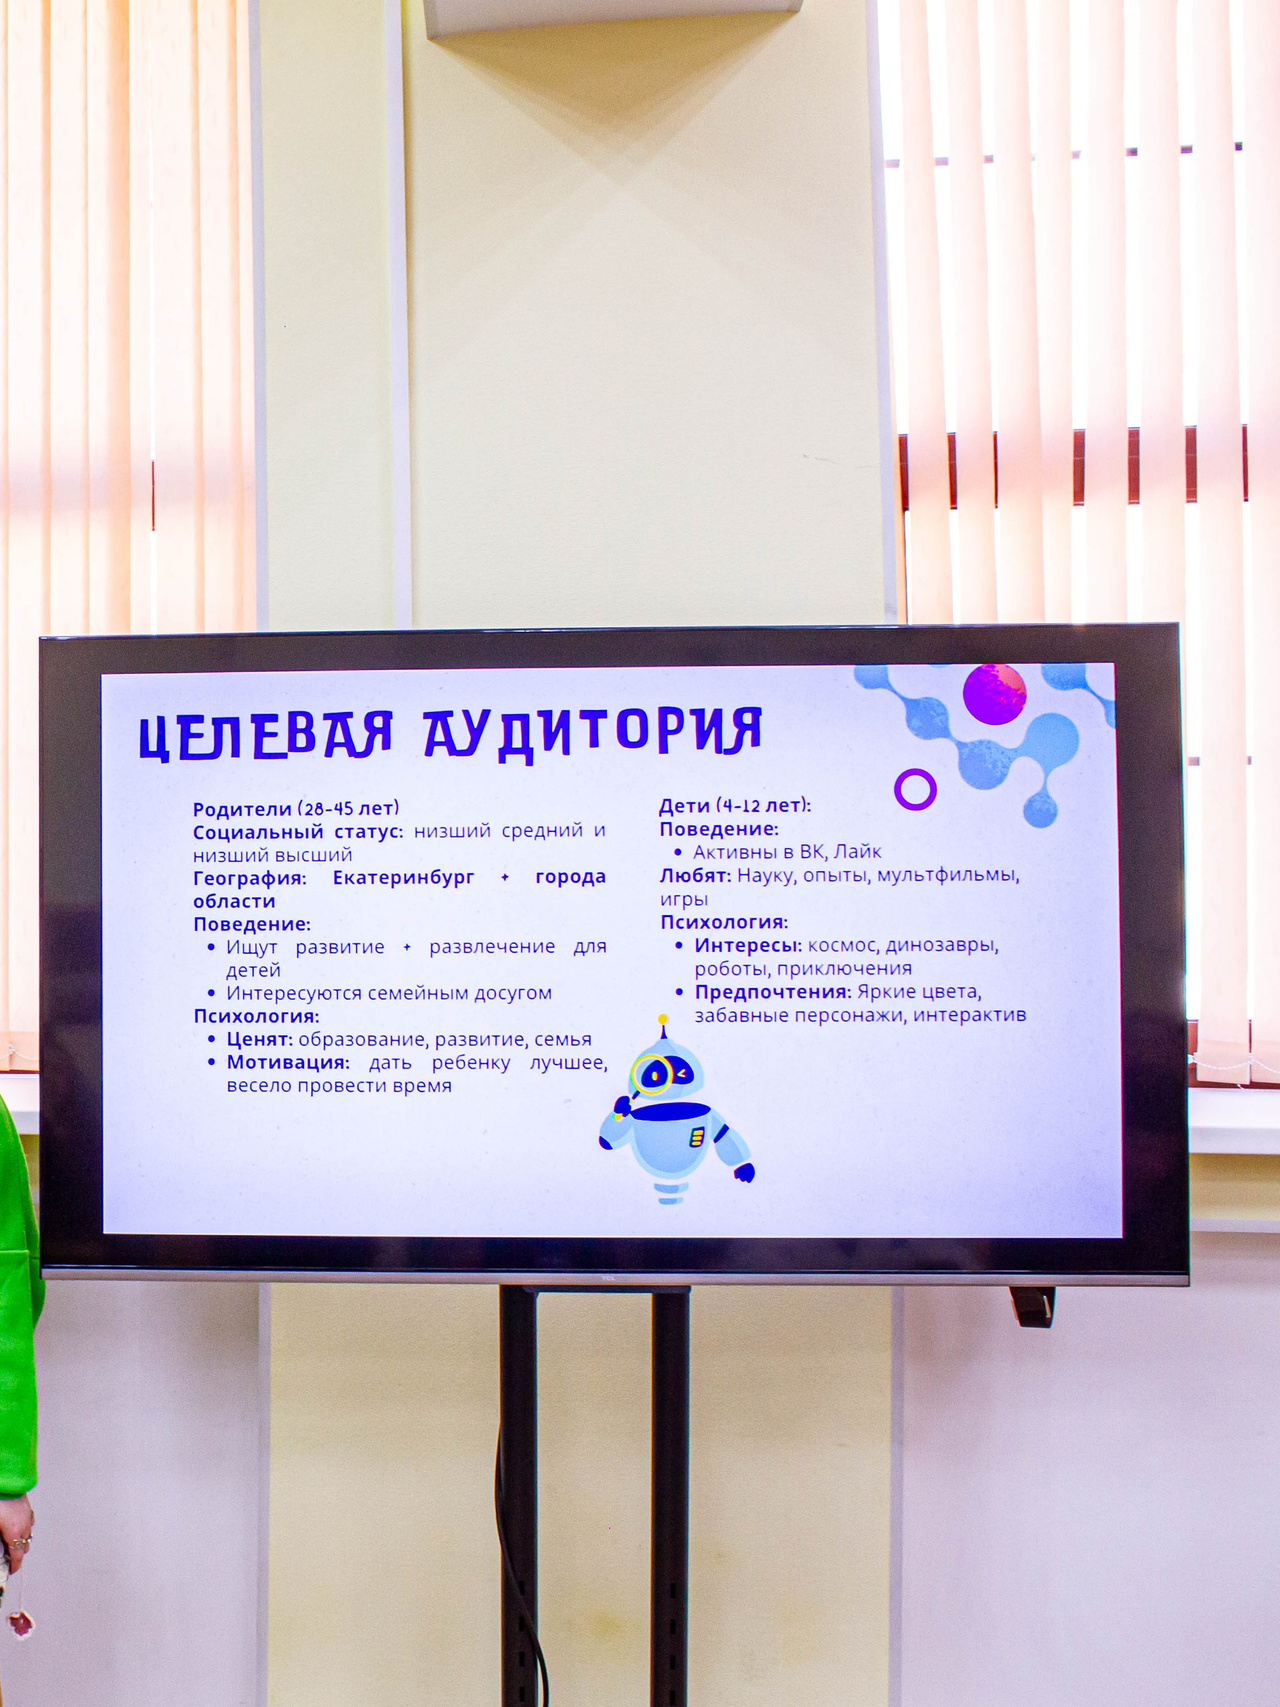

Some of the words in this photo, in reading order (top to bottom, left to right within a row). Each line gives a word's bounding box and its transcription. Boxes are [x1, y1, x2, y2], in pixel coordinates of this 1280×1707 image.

[138, 709, 394, 765] ЦЕЛЕВАЯ
[422, 705, 764, 768] АУДИТОРИЯ
[193, 801, 292, 821] Родители
[297, 798, 354, 817] (28-45
[357, 798, 400, 816] лет)
[658, 797, 710, 818] Дети
[715, 795, 761, 814] (4-12
[764, 795, 812, 813] лет):
[192, 822, 324, 844] Социальный
[334, 826, 404, 844] статус:
[414, 821, 491, 839] низший
[501, 821, 583, 843] средний
[594, 825, 606, 838] и
[659, 821, 780, 841] Поведение:
[193, 846, 269, 864] низший
[275, 846, 353, 863] высший
[692, 844, 778, 860] Активны
[783, 847, 795, 860] в
[800, 843, 829, 863] ВК,
[832, 842, 883, 860] Лайк
[193, 869, 307, 891] География:
[333, 868, 476, 890] Екатеринбург
[535, 871, 606, 889] города
[658, 866, 732, 884] Любят:
[737, 867, 798, 888] Науку,
[803, 870, 872, 886] опыты,
[877, 865, 1021, 887] мультфильмы,
[193, 892, 276, 909] области
[660, 894, 709, 911] игры
[193, 916, 311, 936] Поведение:
[660, 914, 789, 930] Психология:
[226, 939, 279, 960] Ищут
[296, 942, 385, 959] развитие
[429, 941, 556, 959] развлечение
[572, 941, 607, 957] для
[694, 937, 803, 958] Интересы:
[808, 939, 881, 956] космос,
[884, 939, 1000, 957] динозавры,
[225, 961, 281, 982] детей
[695, 959, 772, 981] роботы,
[777, 963, 913, 981] приключения
[227, 985, 362, 1006] Интересуются
[367, 984, 469, 1001] семейным
[473, 987, 552, 1005] досугом
[695, 983, 852, 1005] Предпочтения:
[857, 983, 917, 1004] Яркие
[922, 986, 983, 1003] цвета,
[194, 1008, 320, 1024] Психология:
[694, 1006, 790, 1024] забавные
[795, 1010, 908, 1028] персонажи,
[913, 1009, 1028, 1027] интерактив
[227, 1031, 294, 1051] Ценят:
[298, 1030, 430, 1051] образование,
[435, 1034, 529, 1052] развитие,
[534, 1034, 592, 1047] семья
[227, 1054, 350, 1074] Мотивация:
[368, 1057, 413, 1074] дать
[432, 1053, 512, 1075] ребенку
[529, 1057, 608, 1075] лучшее,
[227, 1080, 292, 1093] весело
[298, 1080, 387, 1098] провести
[393, 1080, 452, 1098] время
